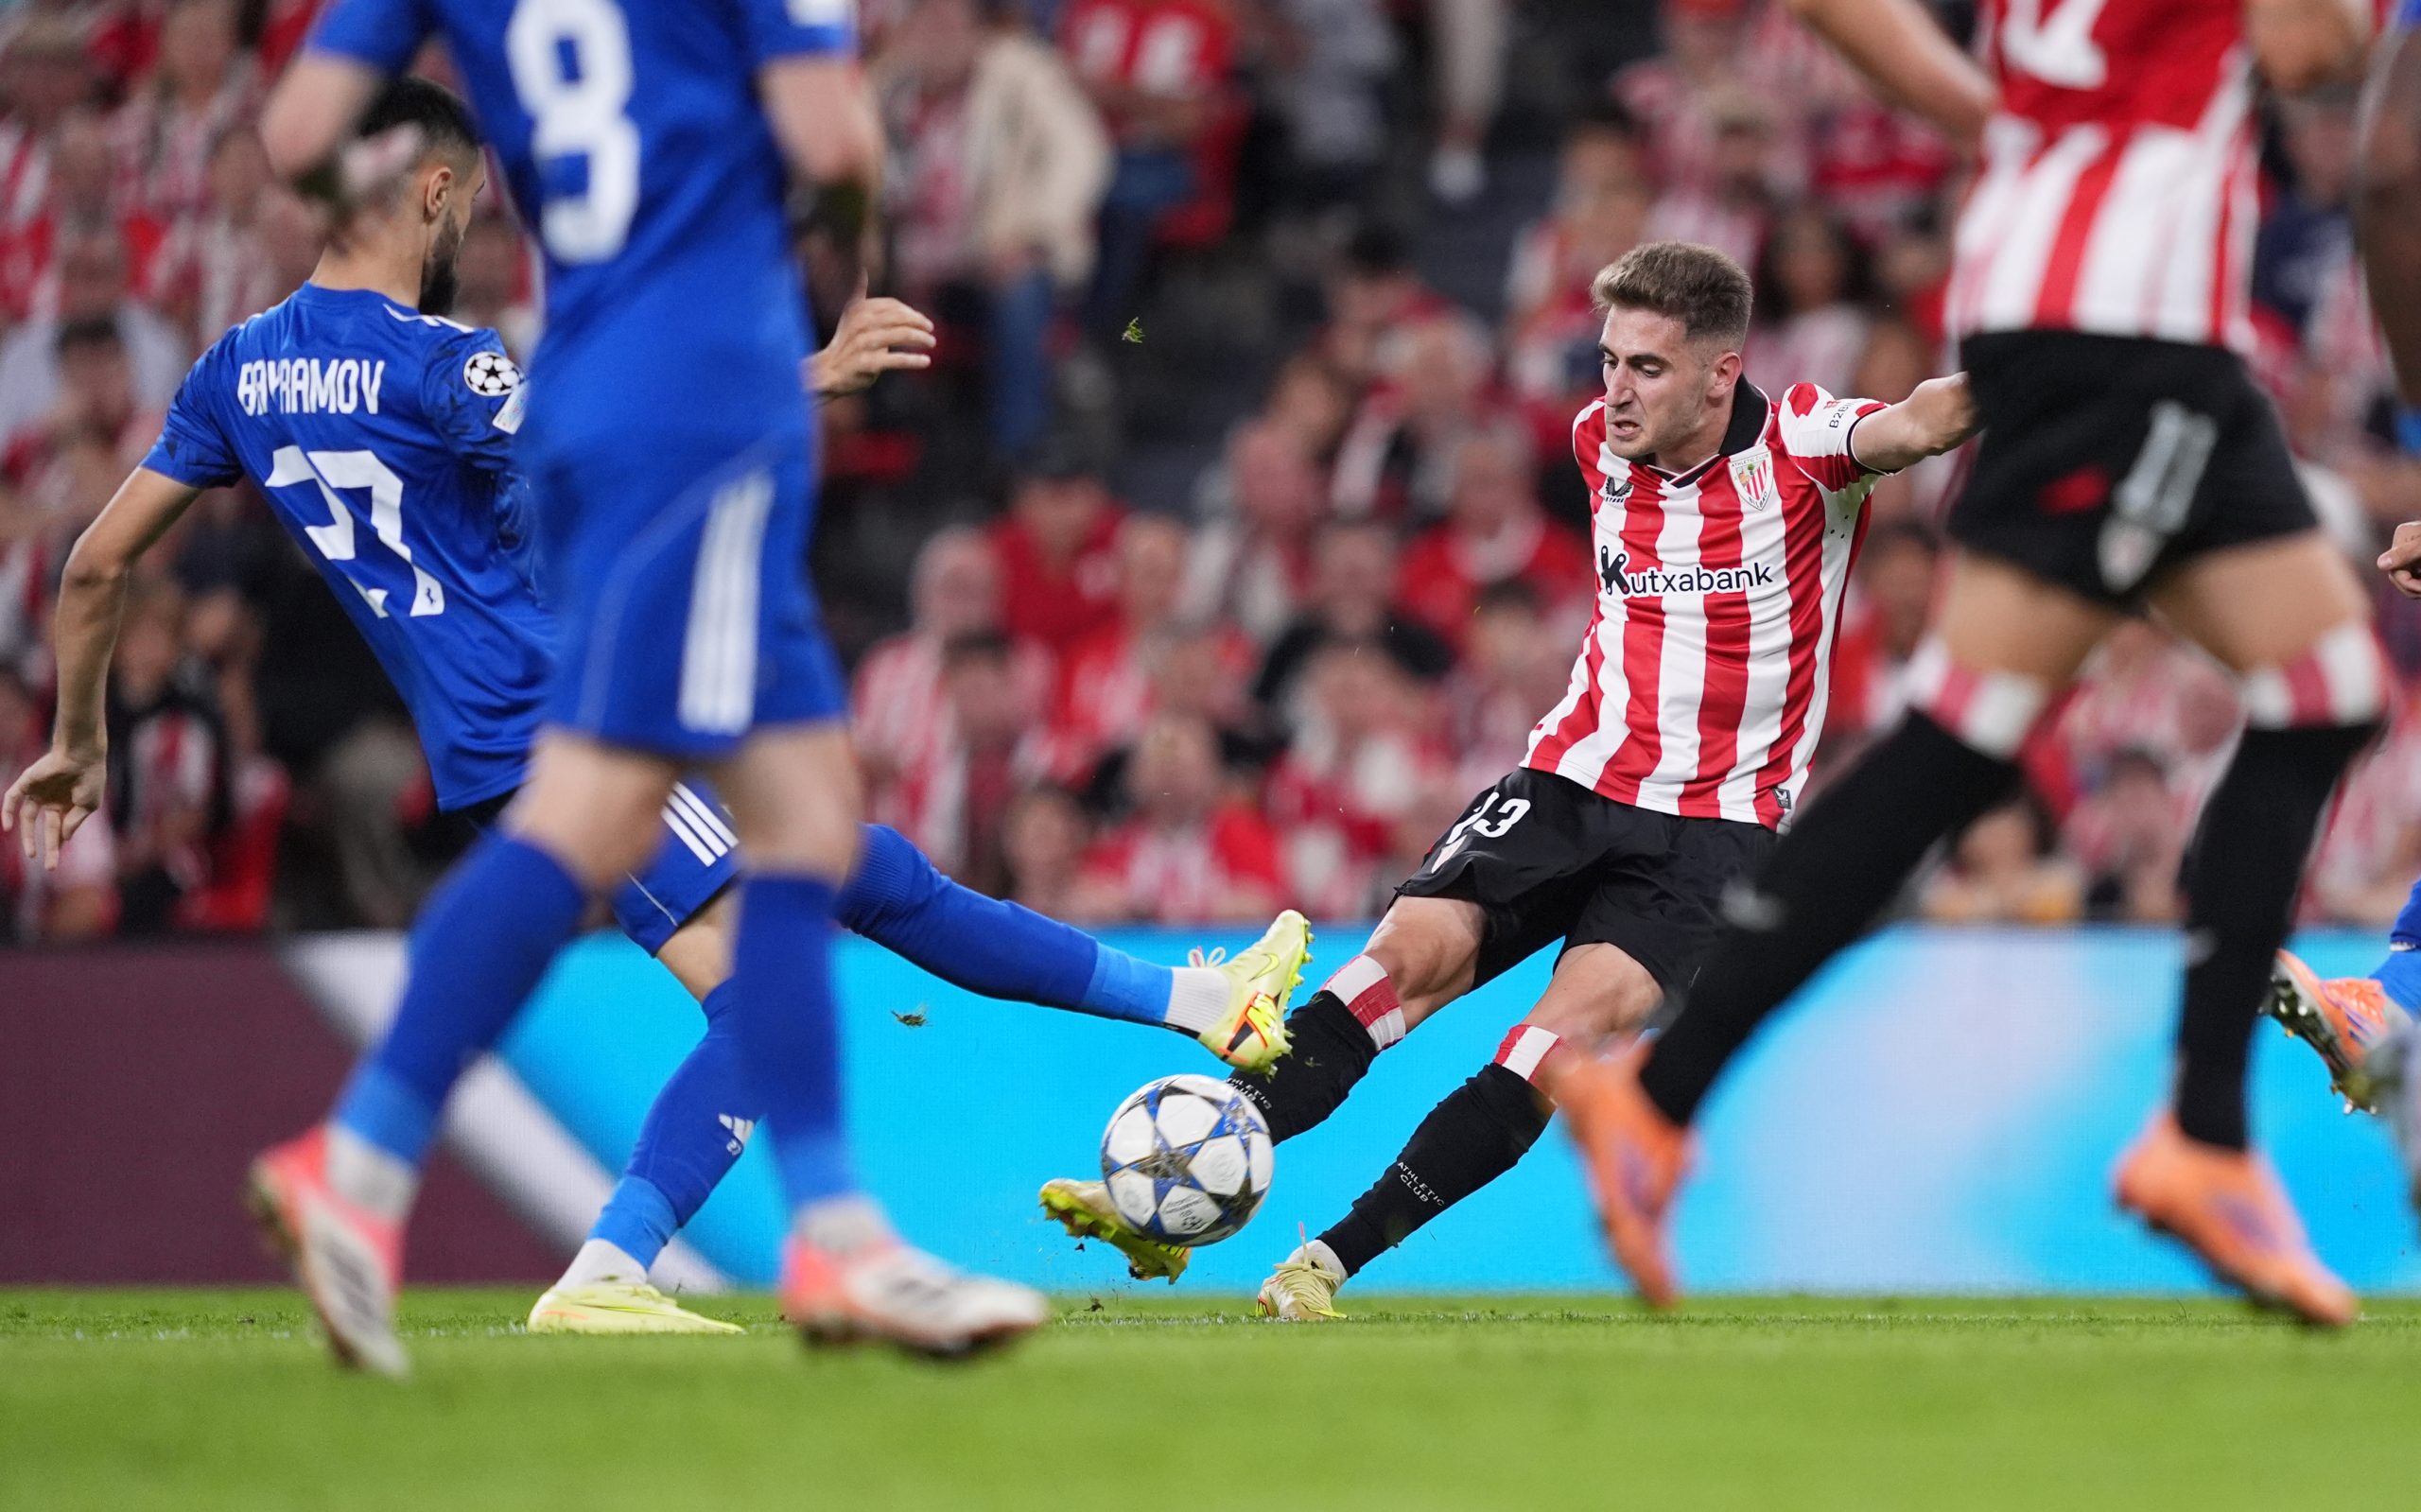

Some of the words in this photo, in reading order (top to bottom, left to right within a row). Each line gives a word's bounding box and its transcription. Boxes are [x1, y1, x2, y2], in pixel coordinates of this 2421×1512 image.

[237, 357, 385, 416] BAYRAMOV
[1601, 545, 1774, 596] Kutxabank
[1398, 1162, 1445, 1207] ATHLETIC
[1400, 1173, 1429, 1202] CLUB
